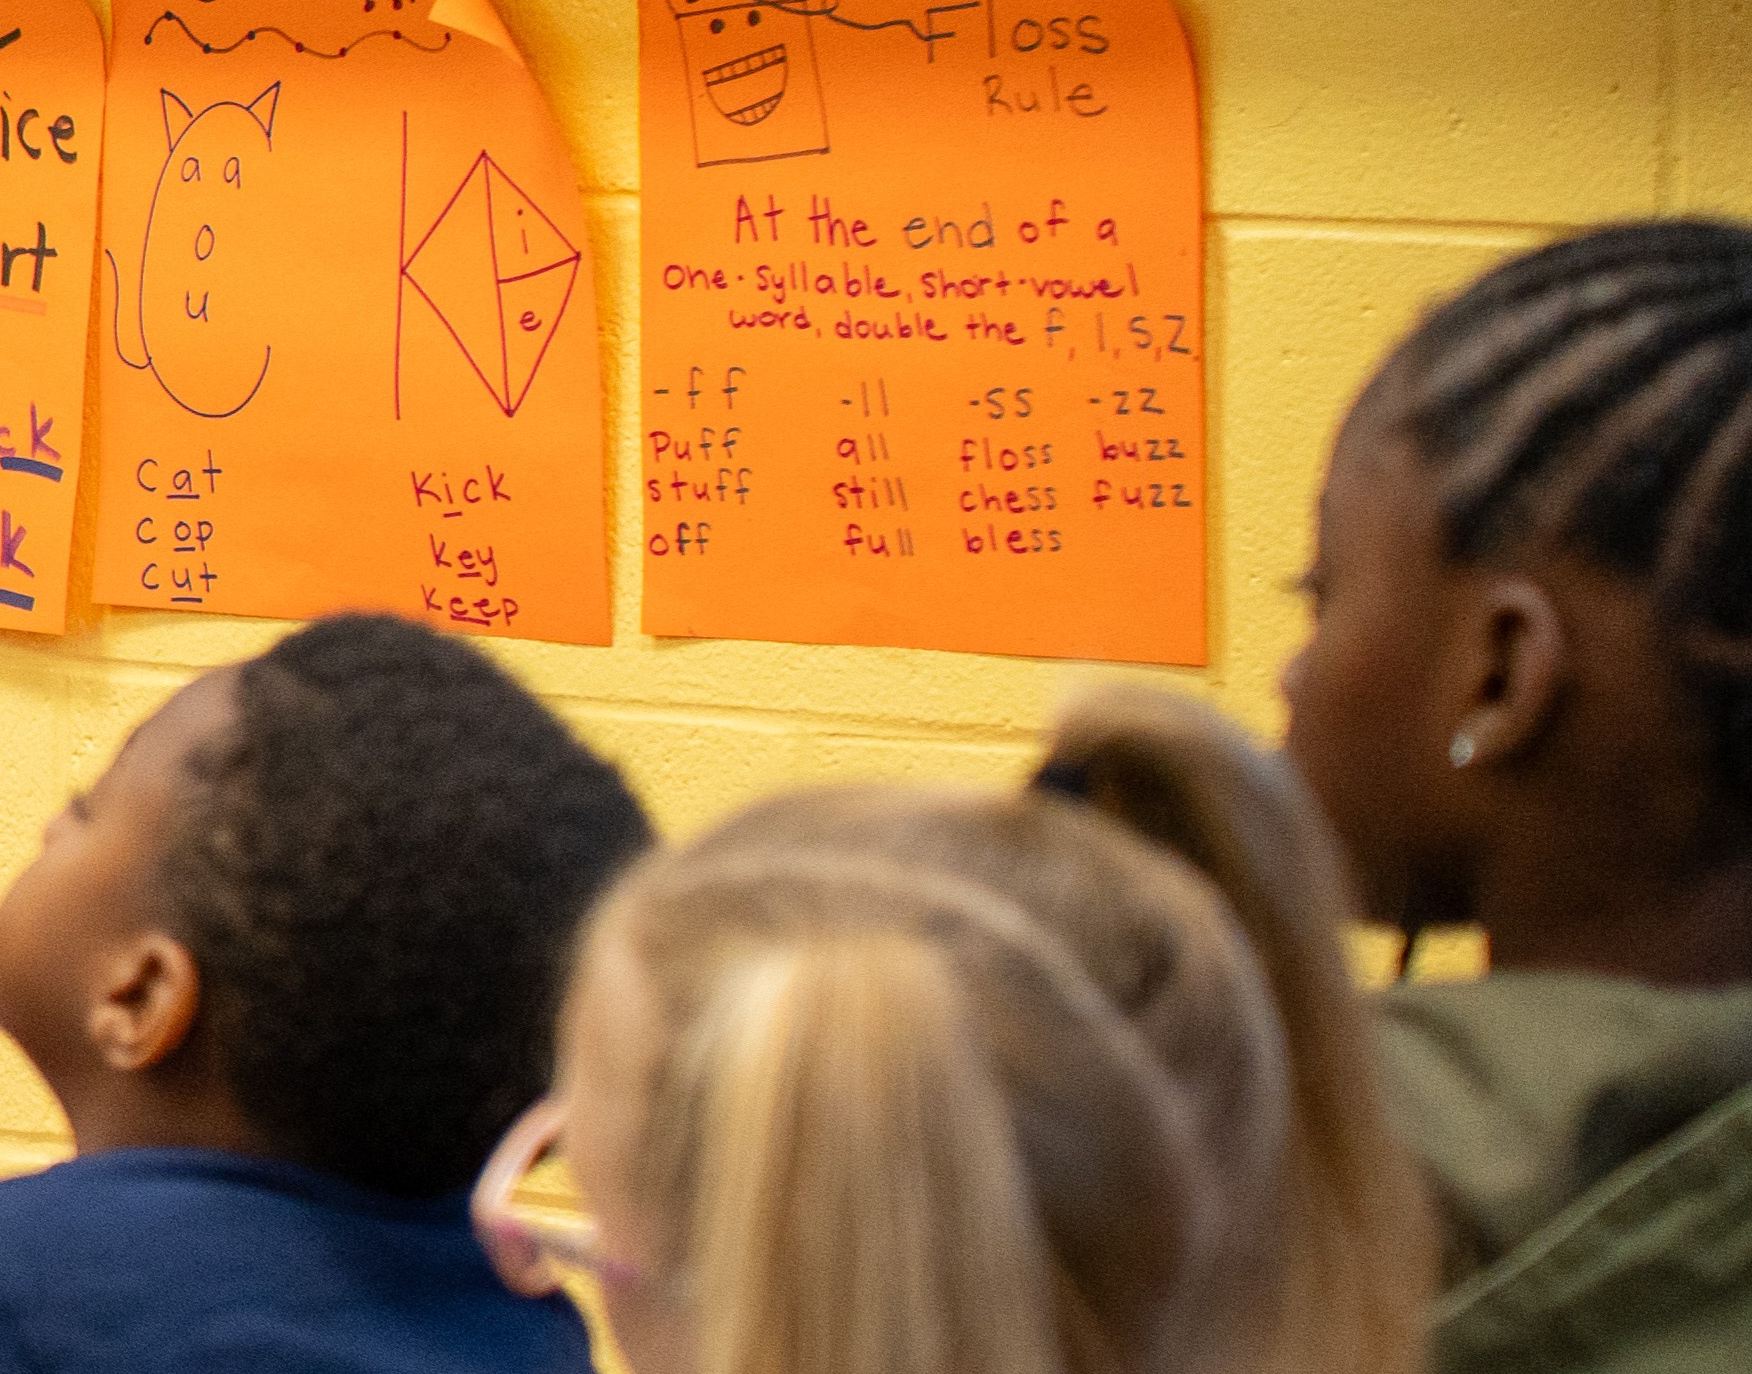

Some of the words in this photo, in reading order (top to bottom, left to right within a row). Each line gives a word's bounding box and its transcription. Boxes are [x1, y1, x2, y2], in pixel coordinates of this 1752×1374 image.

[982, 65, 1109, 117] Rule
[734, 193, 785, 245] At
[807, 193, 879, 248] the
[902, 201, 996, 250] end
[1017, 199, 1070, 244] of
[1095, 217, 1120, 247] a
[834, 312, 948, 342] double
[965, 314, 1027, 345] the
[837, 432, 891, 461] all
[959, 436, 1054, 472] floss
[1099, 430, 1186, 462] buzz
[647, 467, 752, 505] stuff
[832, 476, 910, 512] still
[958, 485, 1058, 514] chess
[1093, 479, 1194, 510] fuzz
[647, 522, 713, 557] off
[843, 523, 917, 559] full
[961, 528, 1064, 554] bless
